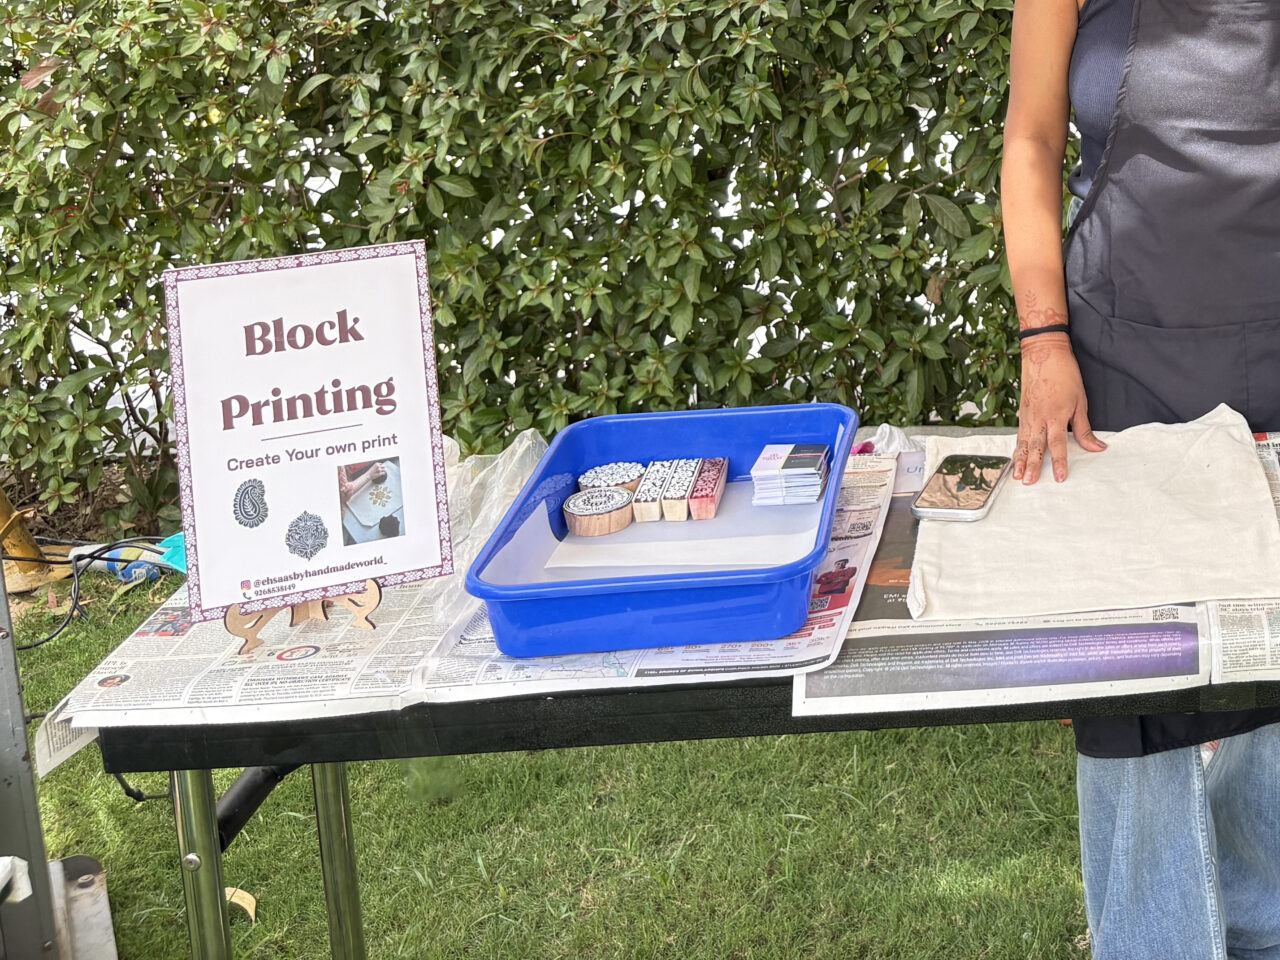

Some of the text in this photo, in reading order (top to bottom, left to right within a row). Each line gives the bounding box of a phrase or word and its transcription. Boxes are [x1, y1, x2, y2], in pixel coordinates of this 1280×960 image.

[243, 308, 364, 356] Block
[220, 376, 397, 431] Printing
[227, 433, 398, 472] Create Your own print
[254, 556, 388, 587] @ehsaasbyhandmadeworld_
